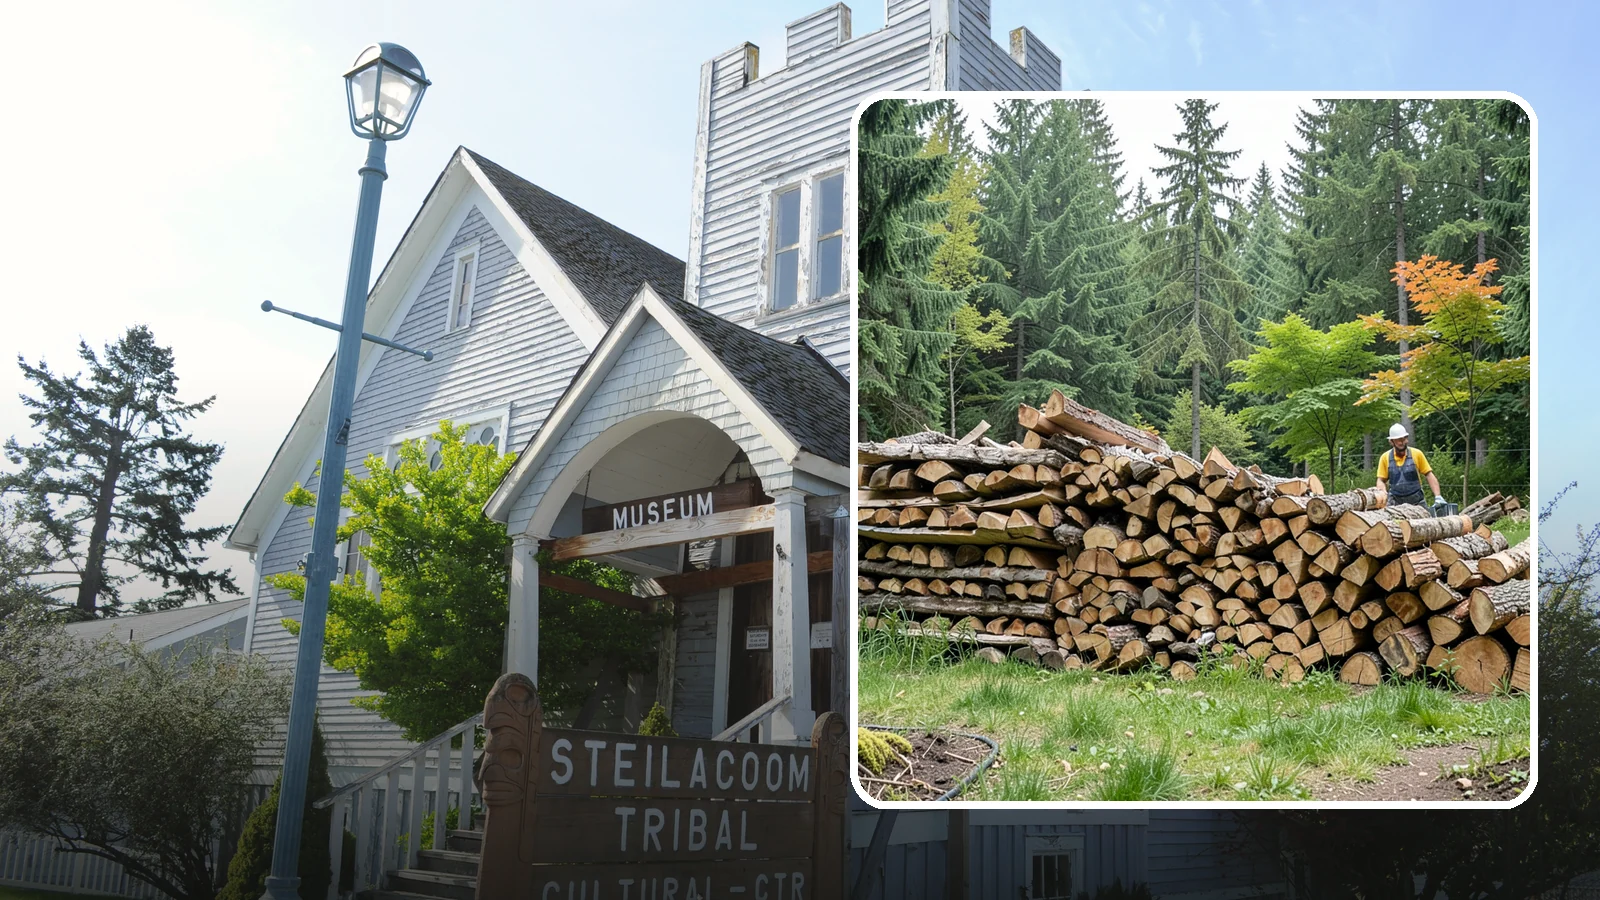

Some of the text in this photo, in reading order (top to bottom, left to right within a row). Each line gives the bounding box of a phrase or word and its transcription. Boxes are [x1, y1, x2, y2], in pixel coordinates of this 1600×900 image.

[612, 491, 713, 531] MUSEUM
[550, 738, 809, 792] STEILACOOM
[614, 806, 758, 852] TRIBAL
[754, 871, 805, 900] CTR
